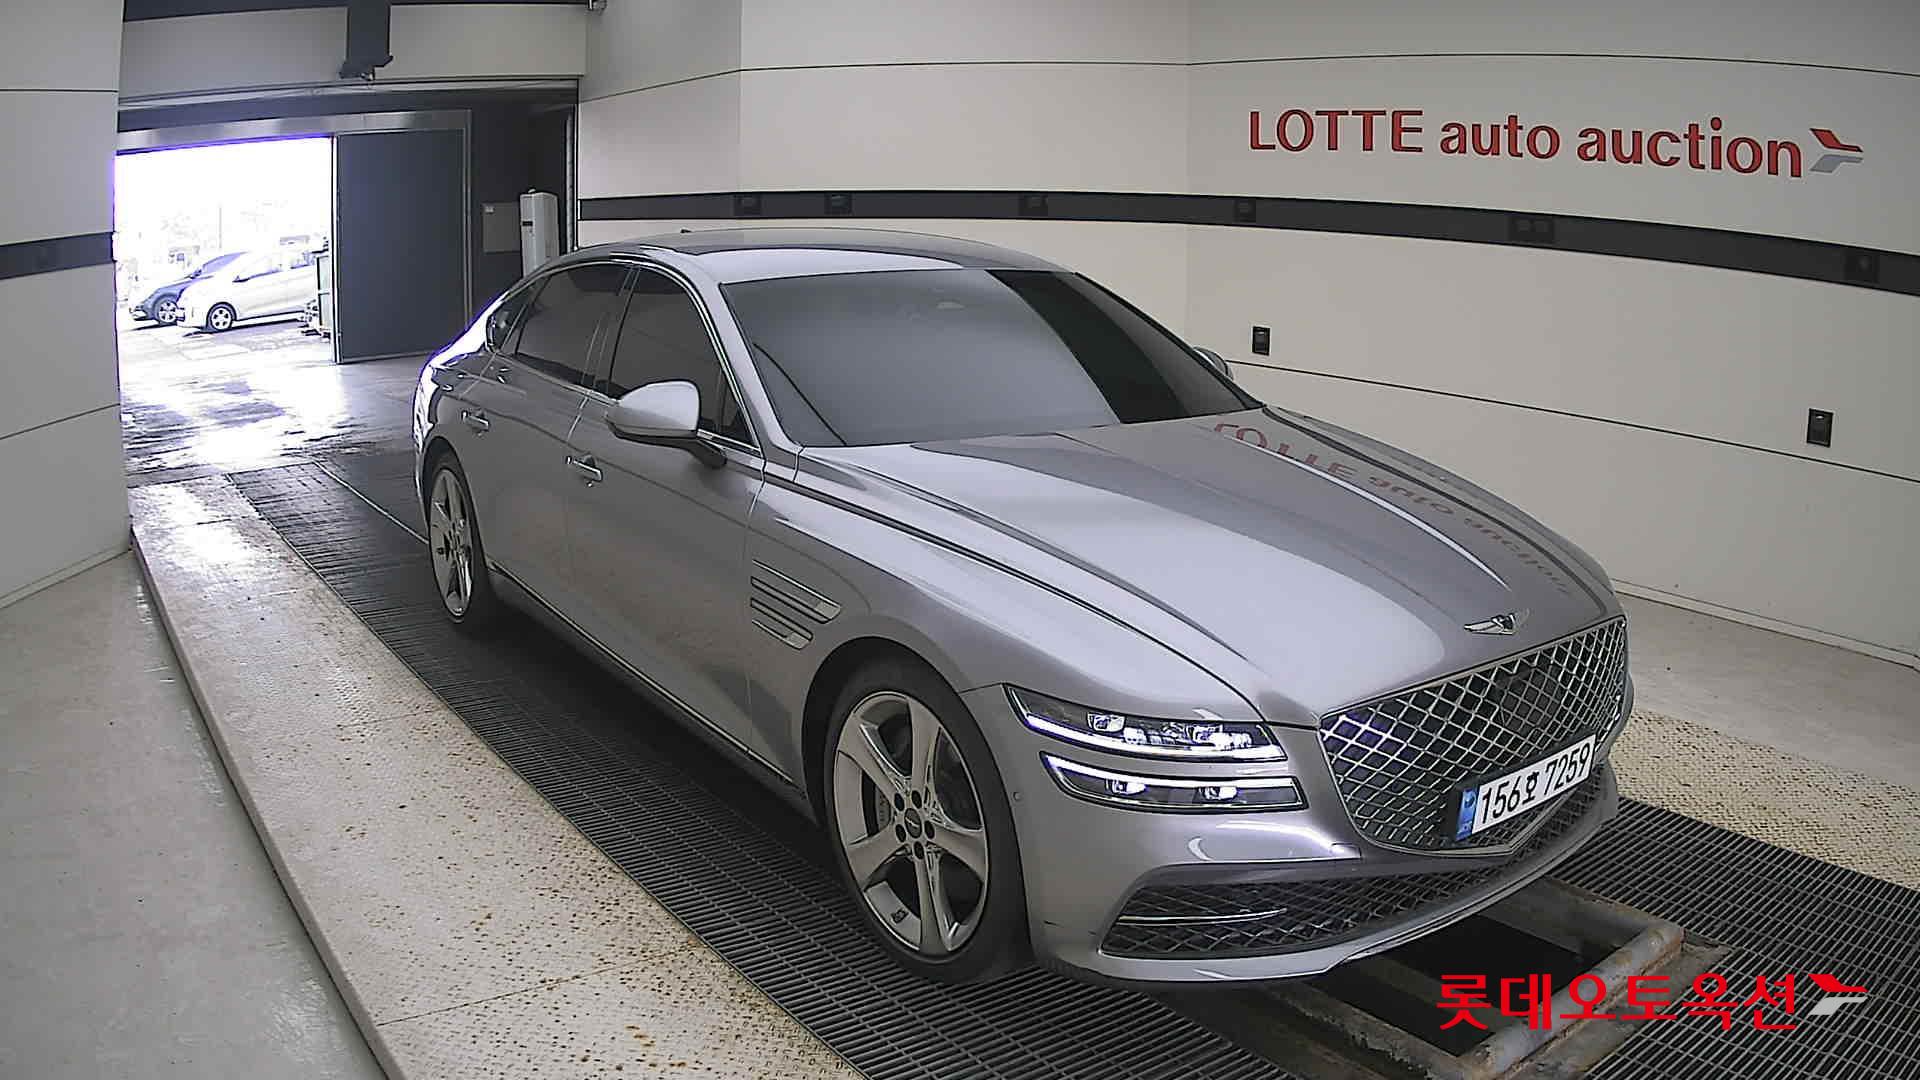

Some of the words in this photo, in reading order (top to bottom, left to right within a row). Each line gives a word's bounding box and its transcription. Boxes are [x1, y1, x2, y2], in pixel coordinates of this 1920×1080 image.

[1248, 109, 1425, 153] LOTTE
[1440, 115, 1561, 159] auto
[1577, 117, 1803, 178] auction
[1544, 742, 1591, 796] 7259
